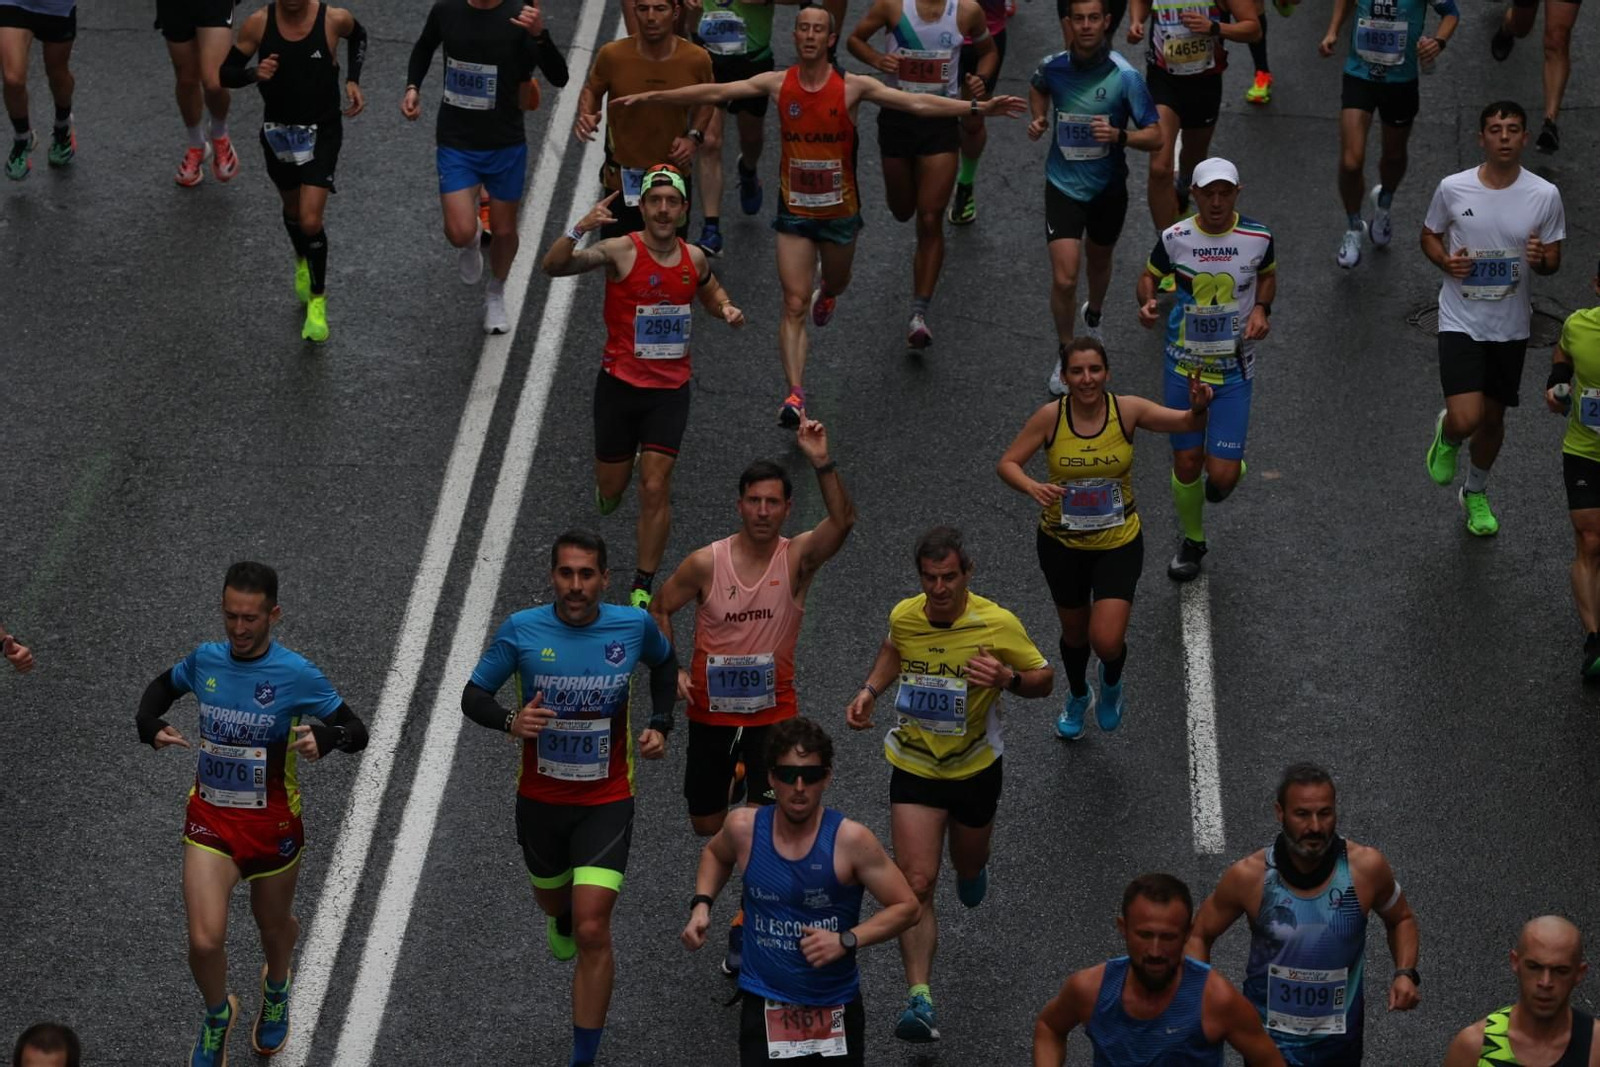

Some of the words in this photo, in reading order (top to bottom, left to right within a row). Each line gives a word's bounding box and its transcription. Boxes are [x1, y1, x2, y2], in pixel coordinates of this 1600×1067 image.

[909, 61, 934, 77] 214
[453, 72, 484, 90] 1846
[1064, 125, 1093, 141] 155
[1193, 248, 1239, 257] FONTANA
[1470, 262, 1507, 278] 2788
[645, 319, 681, 335] 2594
[1193, 317, 1227, 334] 1597
[1058, 455, 1120, 467] OSUNA
[724, 608, 774, 623] MOTRIL
[534, 672, 630, 691] INFORMALES
[718, 670, 761, 689] 1769
[908, 689, 949, 713] 1703
[548, 733, 594, 754] 3178
[205, 757, 248, 783] 3076
[1280, 983, 1329, 1006] 3109
